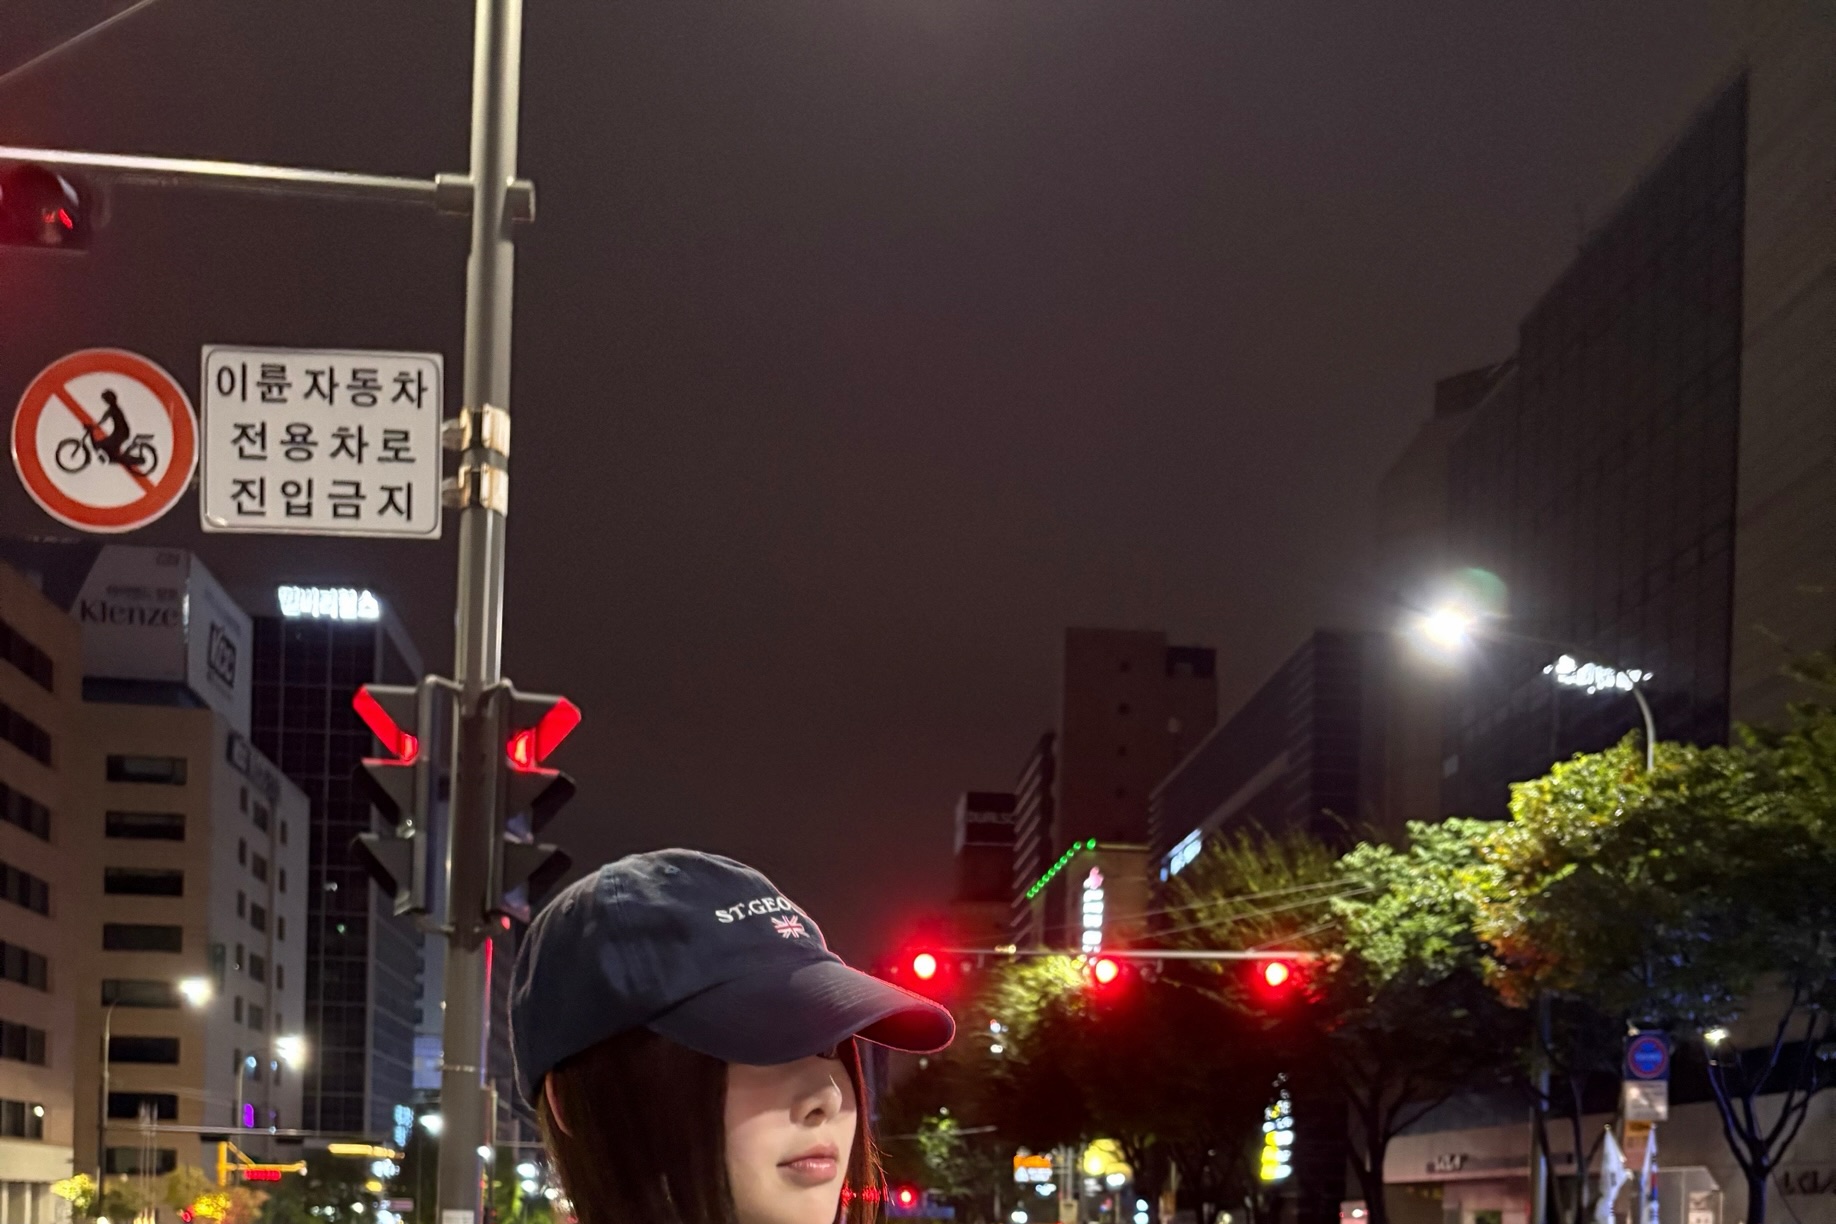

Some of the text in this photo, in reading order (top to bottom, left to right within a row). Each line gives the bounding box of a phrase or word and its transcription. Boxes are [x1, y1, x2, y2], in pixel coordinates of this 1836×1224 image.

[216, 362, 429, 408] 이륜자동차
[230, 421, 417, 464] 전용차로
[230, 477, 413, 521] 진입금지
